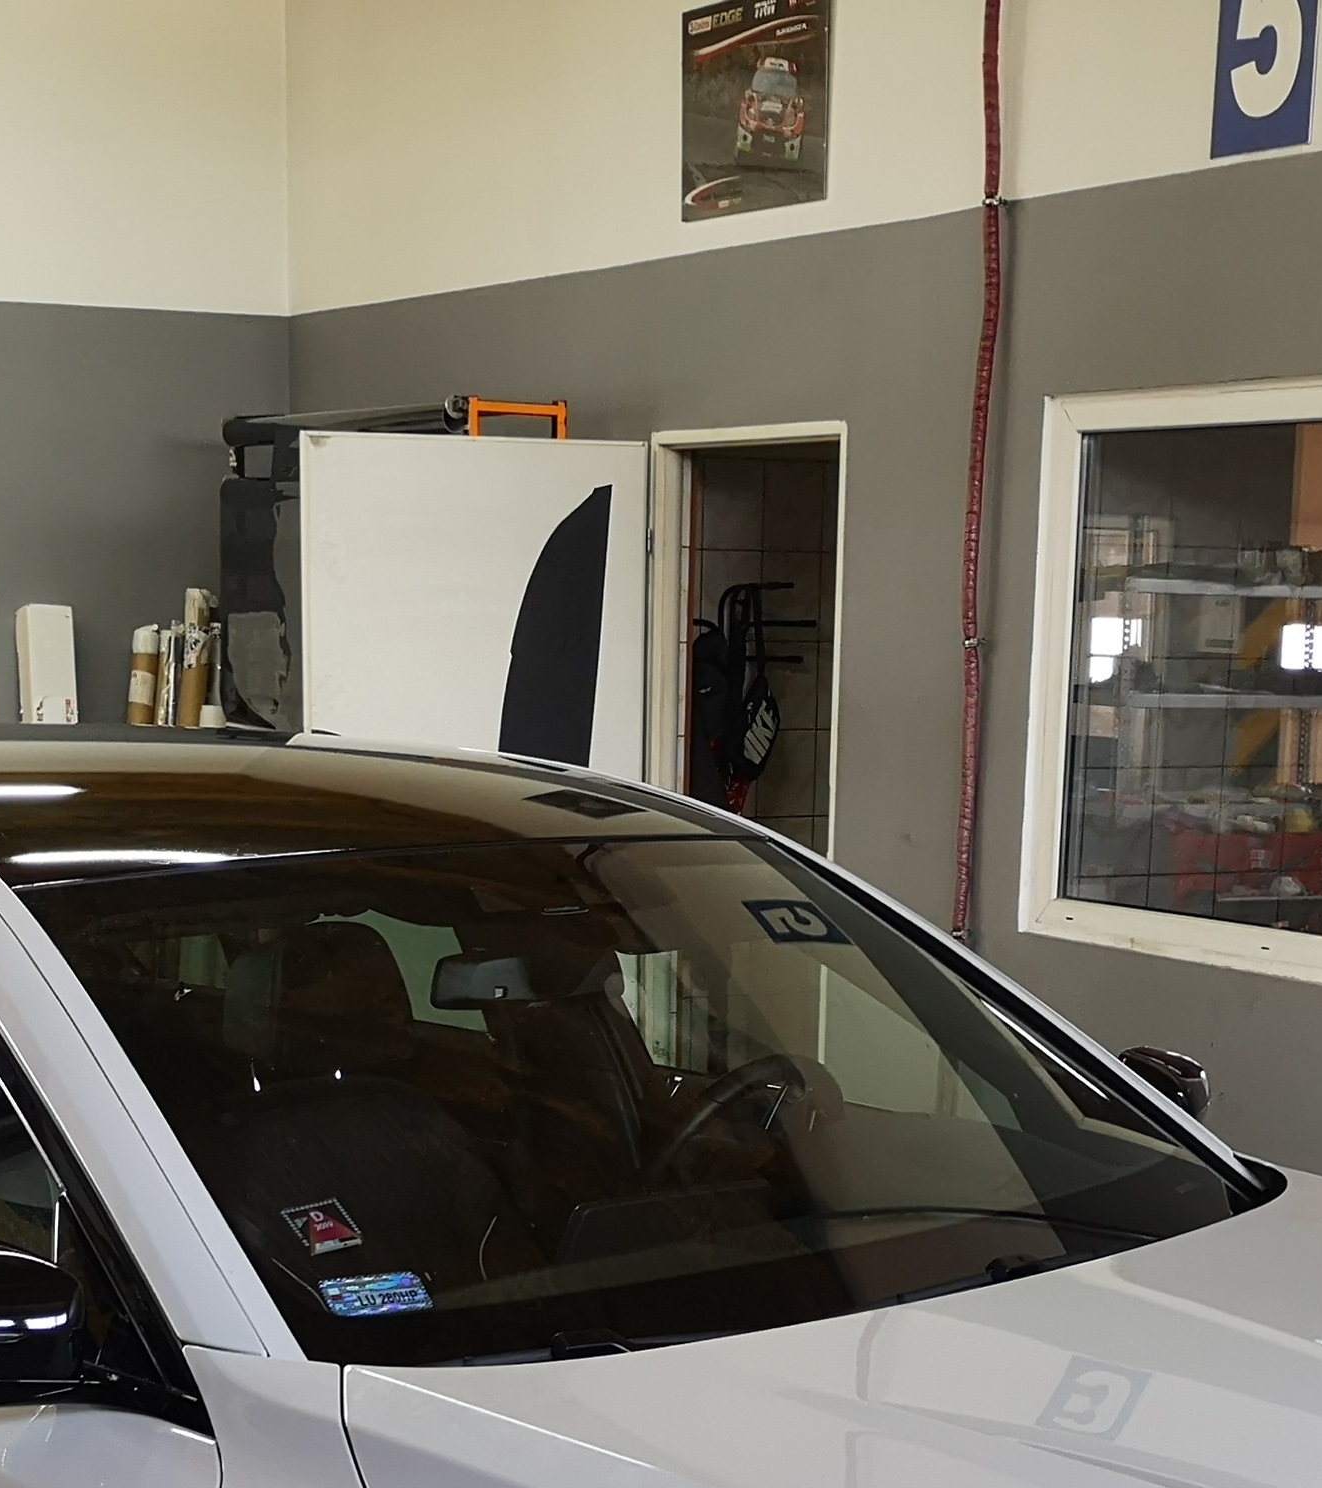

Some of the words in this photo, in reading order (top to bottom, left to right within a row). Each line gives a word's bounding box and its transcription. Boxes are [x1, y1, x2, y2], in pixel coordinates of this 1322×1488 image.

[713, 7, 744, 28] EDGE
[1230, 0, 1303, 118] 5
[743, 700, 778, 765] NIKE
[309, 1211, 324, 1222] D
[357, 1295, 376, 1307] LU
